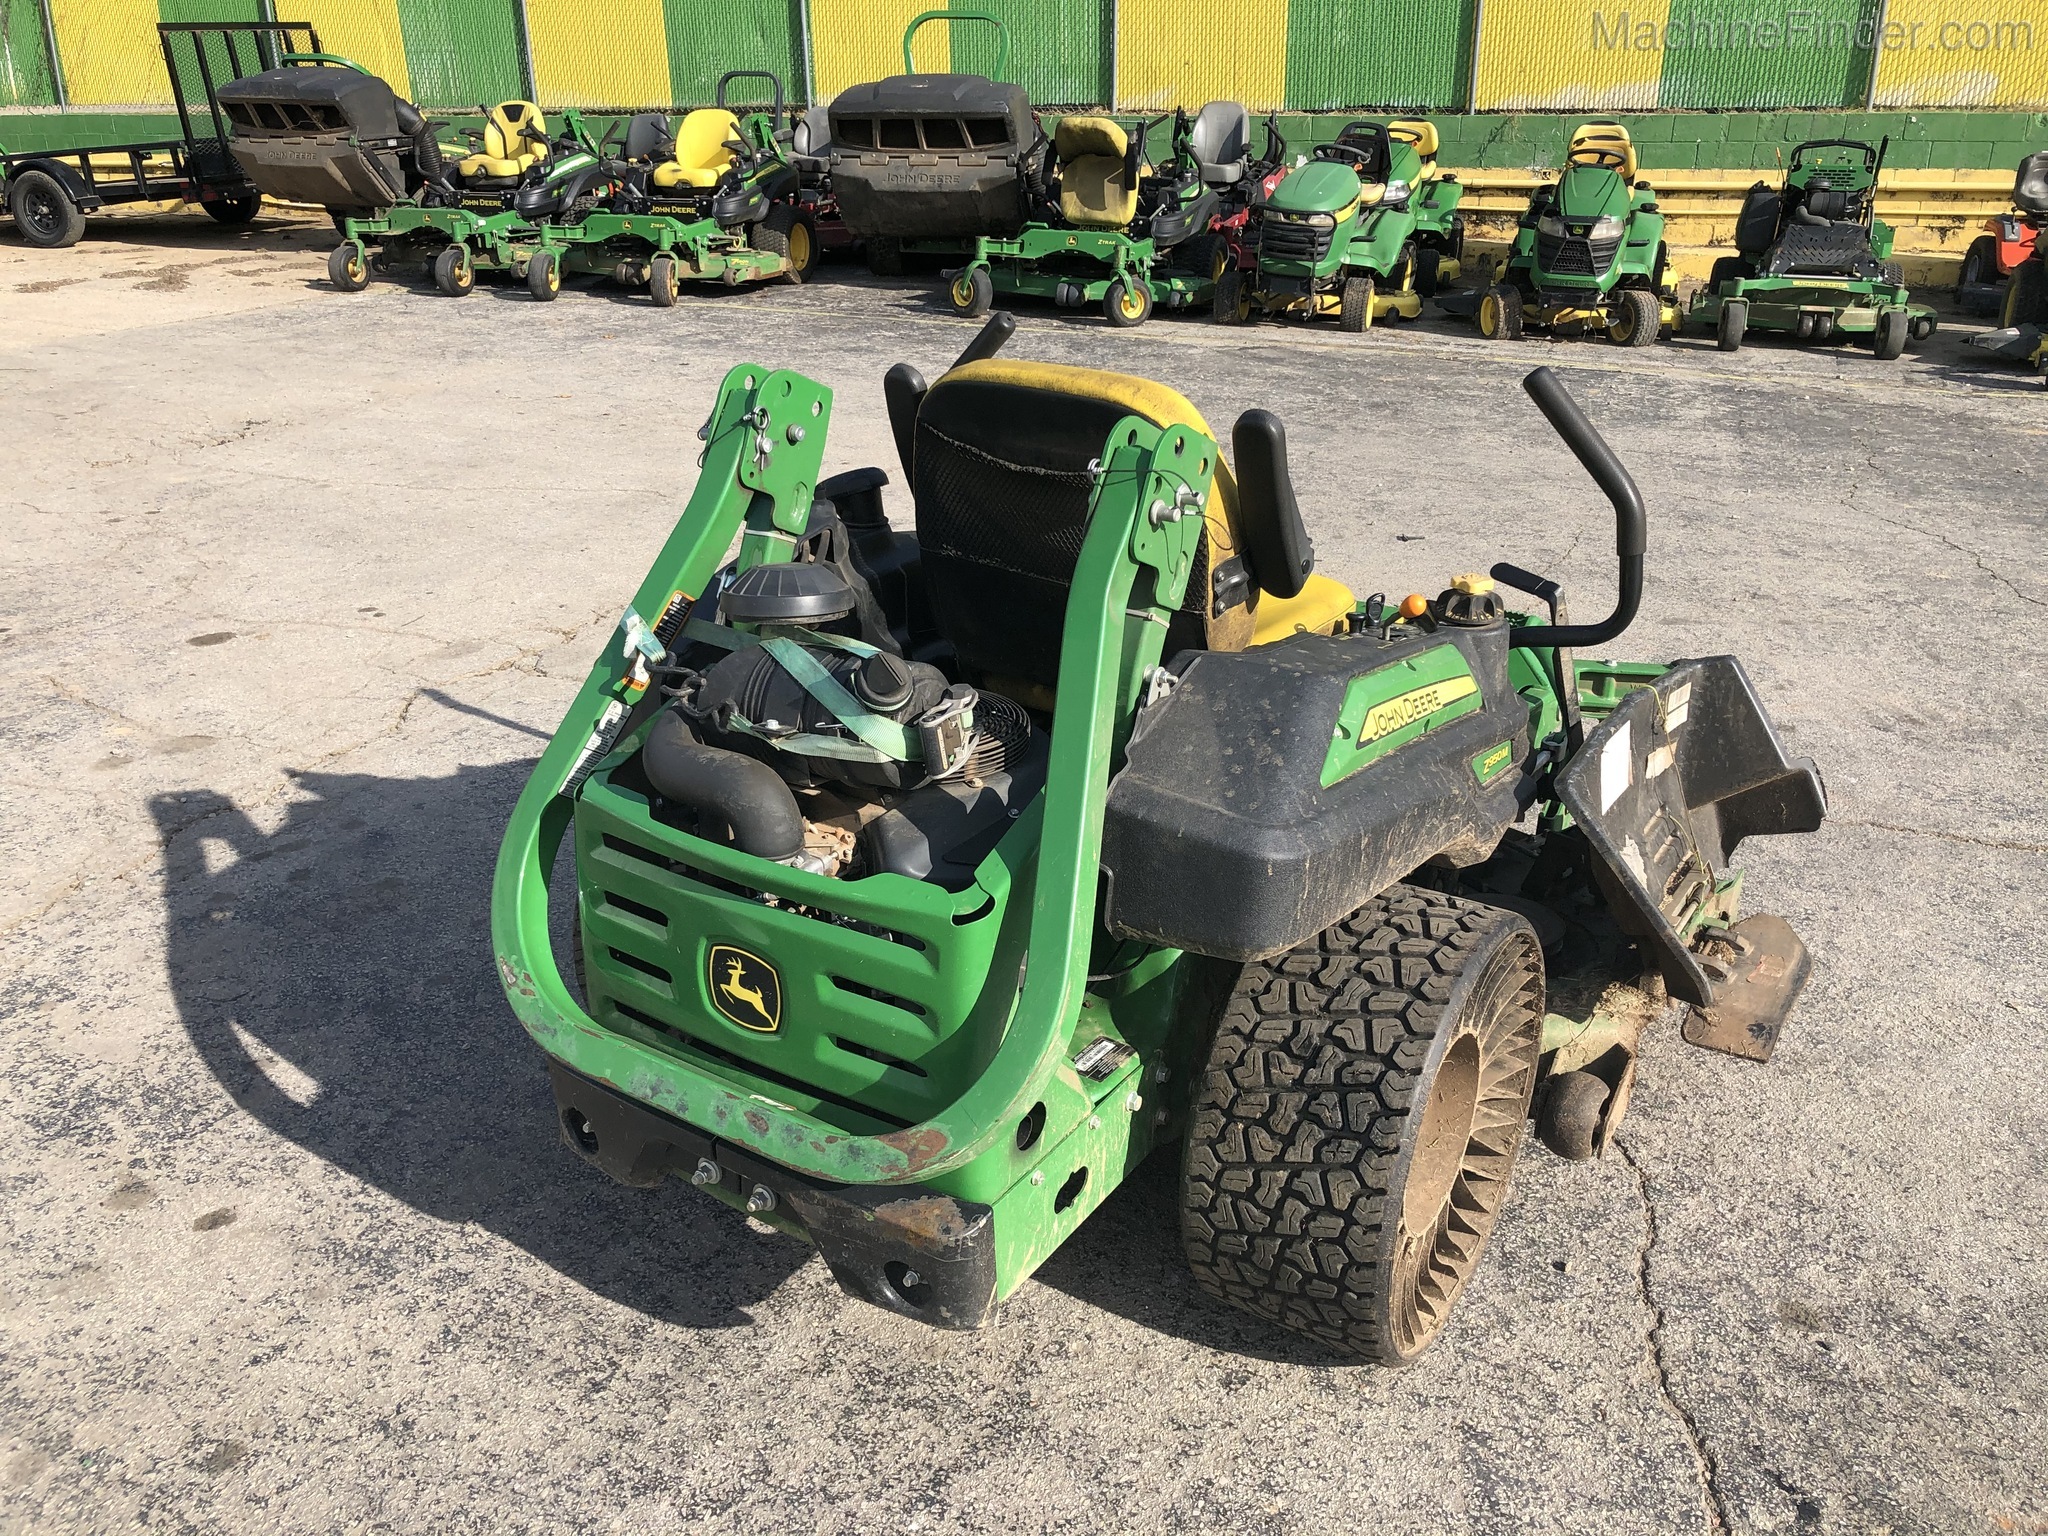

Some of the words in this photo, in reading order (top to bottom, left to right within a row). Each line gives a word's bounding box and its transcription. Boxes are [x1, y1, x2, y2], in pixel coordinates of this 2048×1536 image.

[264, 151, 287, 159] JOHN
[289, 151, 317, 160] DEERE
[886, 173, 916, 183] JOHN
[918, 173, 960, 184] DEERE
[461, 198, 479, 206] JOHN
[480, 199, 502, 207] DEERE
[651, 205, 671, 213] JOHN
[671, 205, 697, 214] DEERE
[1372, 705, 1405, 737] JOHN
[1402, 689, 1442, 720] DEERE
[1483, 746, 1509, 775] Z950M
